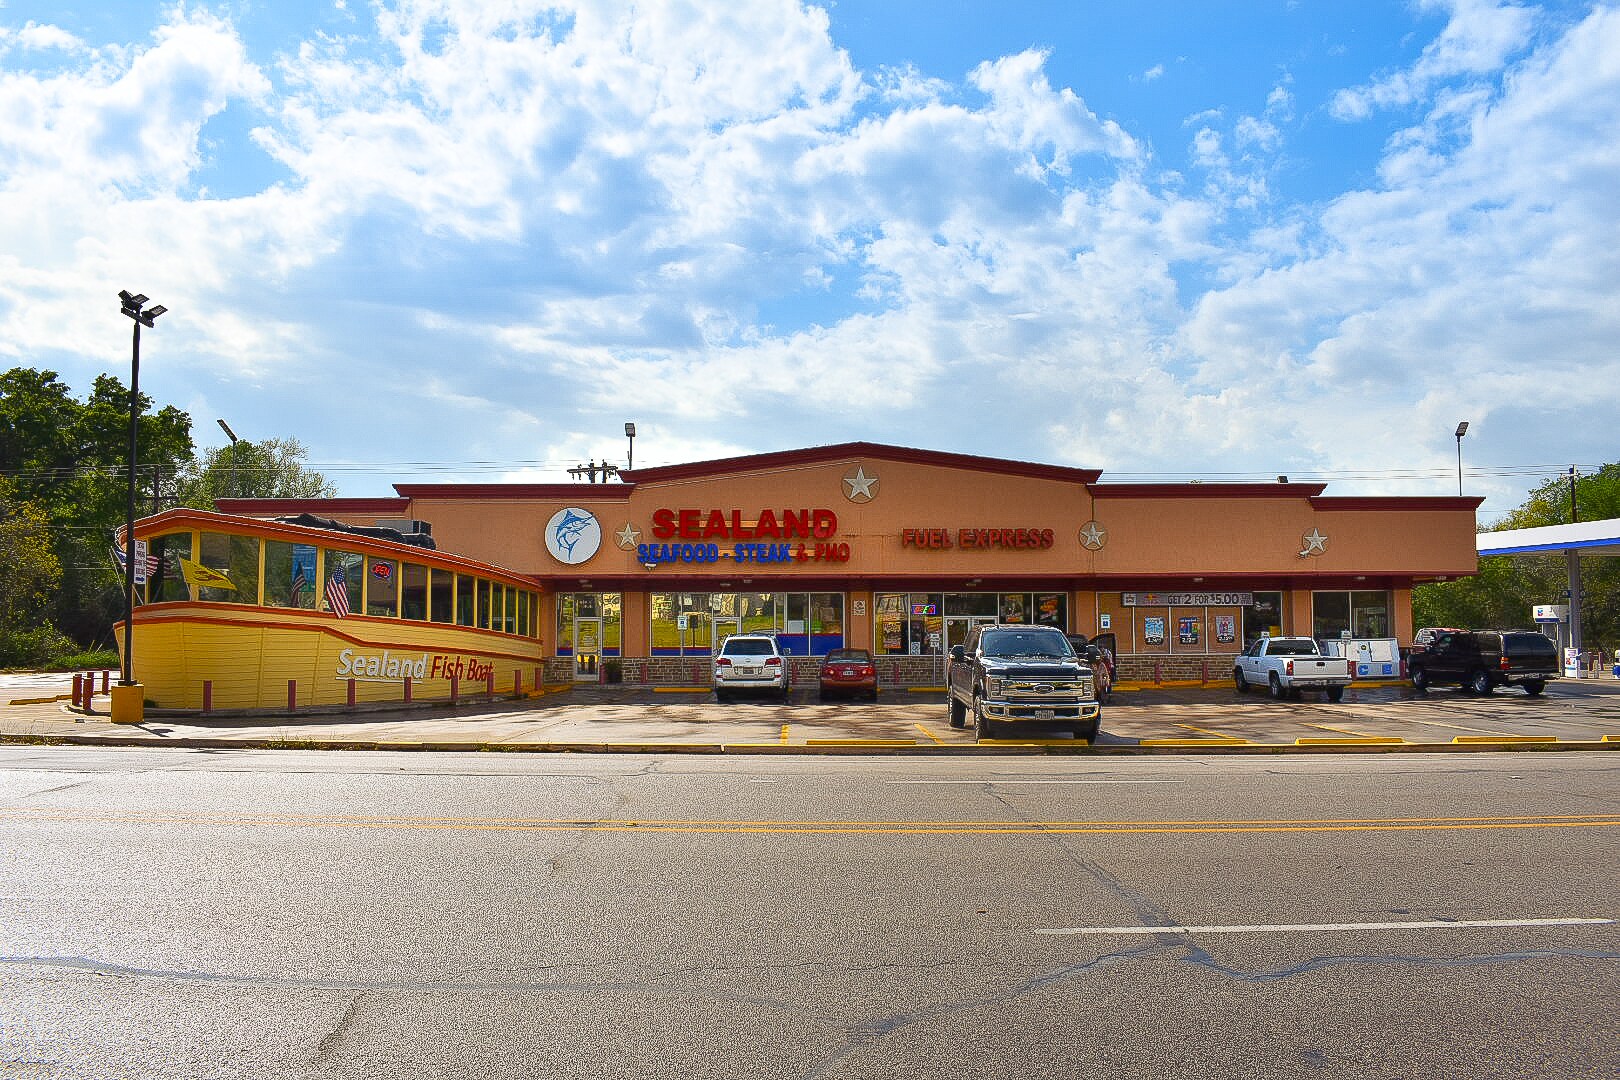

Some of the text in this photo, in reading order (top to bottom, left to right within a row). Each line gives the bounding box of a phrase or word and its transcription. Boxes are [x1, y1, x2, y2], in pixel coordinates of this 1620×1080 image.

[652, 508, 838, 539] SEALAND
[902, 528, 1055, 549] FUEL EXPRESS
[637, 543, 719, 563] SEAFOOD
[733, 543, 793, 563] STEAK
[797, 543, 809, 562] &
[815, 542, 850, 562] PHO
[373, 564, 391, 577] OPEN
[1168, 594, 1183, 604] GET
[1184, 594, 1192, 605] 2
[1194, 594, 1209, 604] FOR
[1210, 593, 1239, 605] $5.00
[336, 648, 494, 682] Sealand Fish Boat
